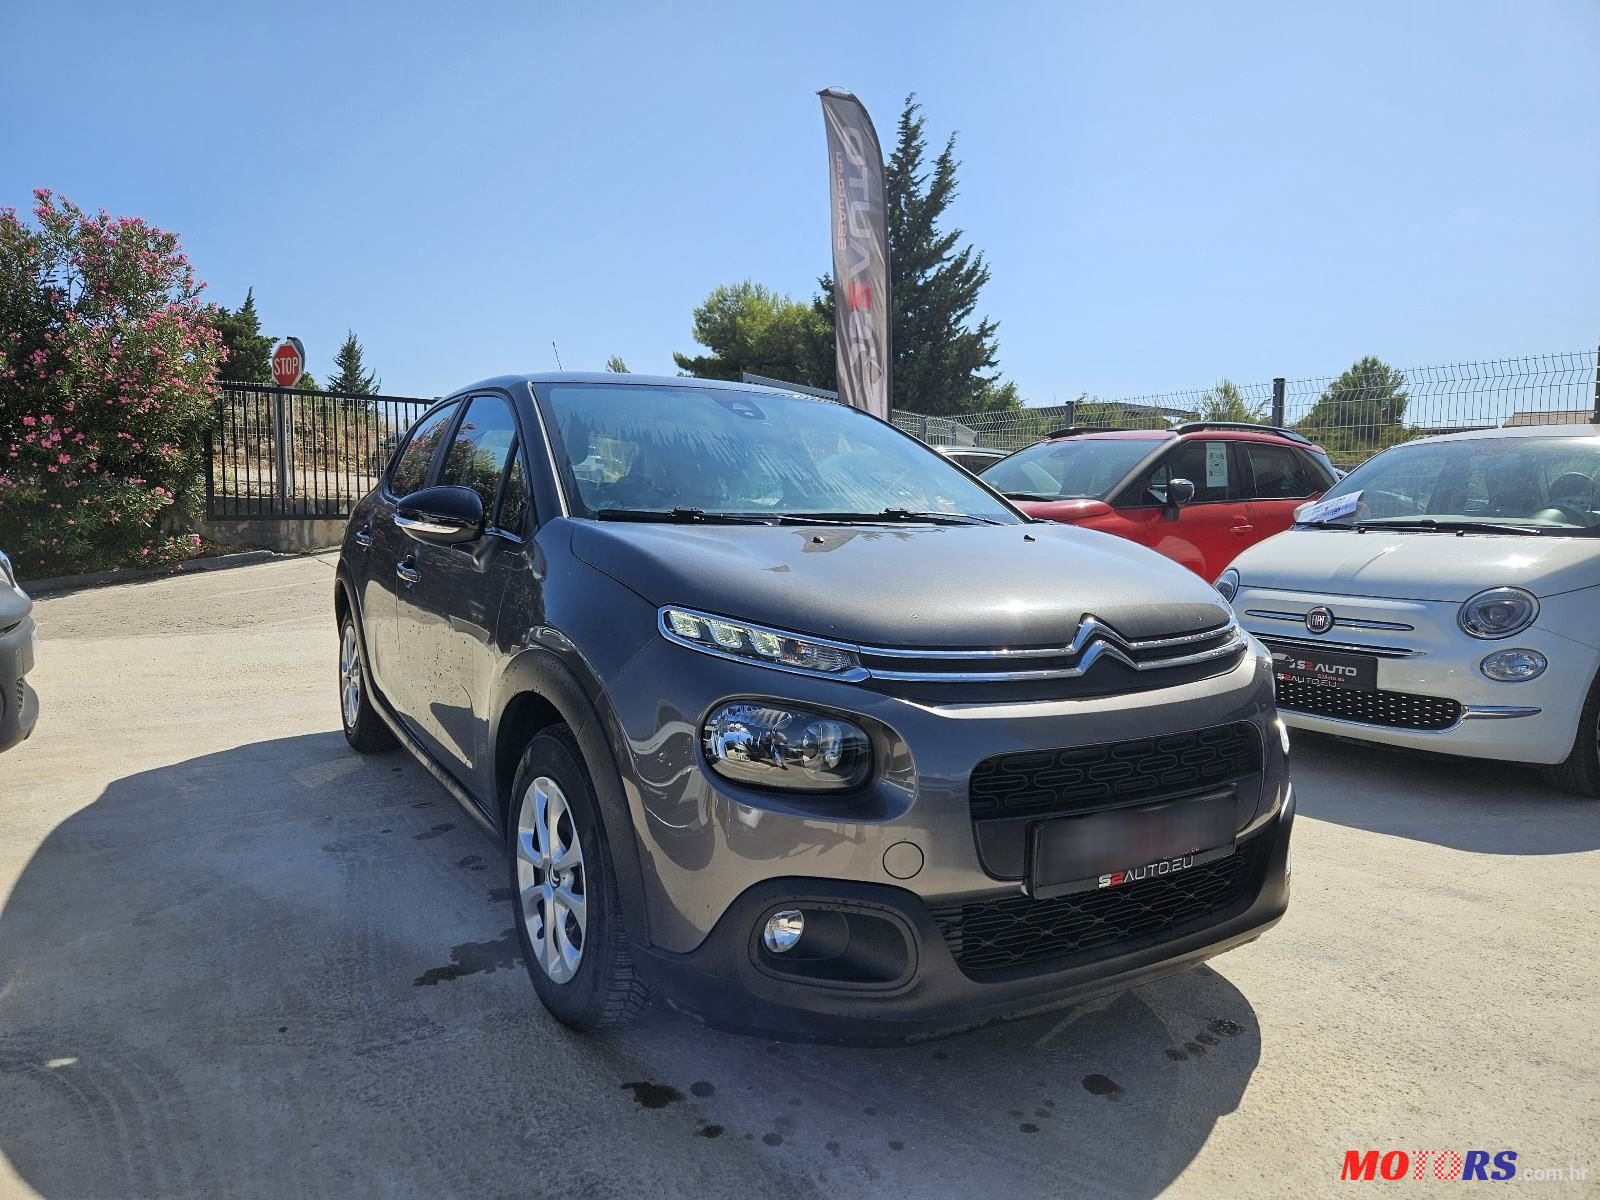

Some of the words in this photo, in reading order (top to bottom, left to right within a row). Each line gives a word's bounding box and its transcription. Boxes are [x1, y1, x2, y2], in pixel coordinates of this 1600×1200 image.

[274, 356, 299, 376] STOP
[1311, 614, 1326, 627] FIAT
[1098, 855, 1195, 889] S2AUTO.EU
